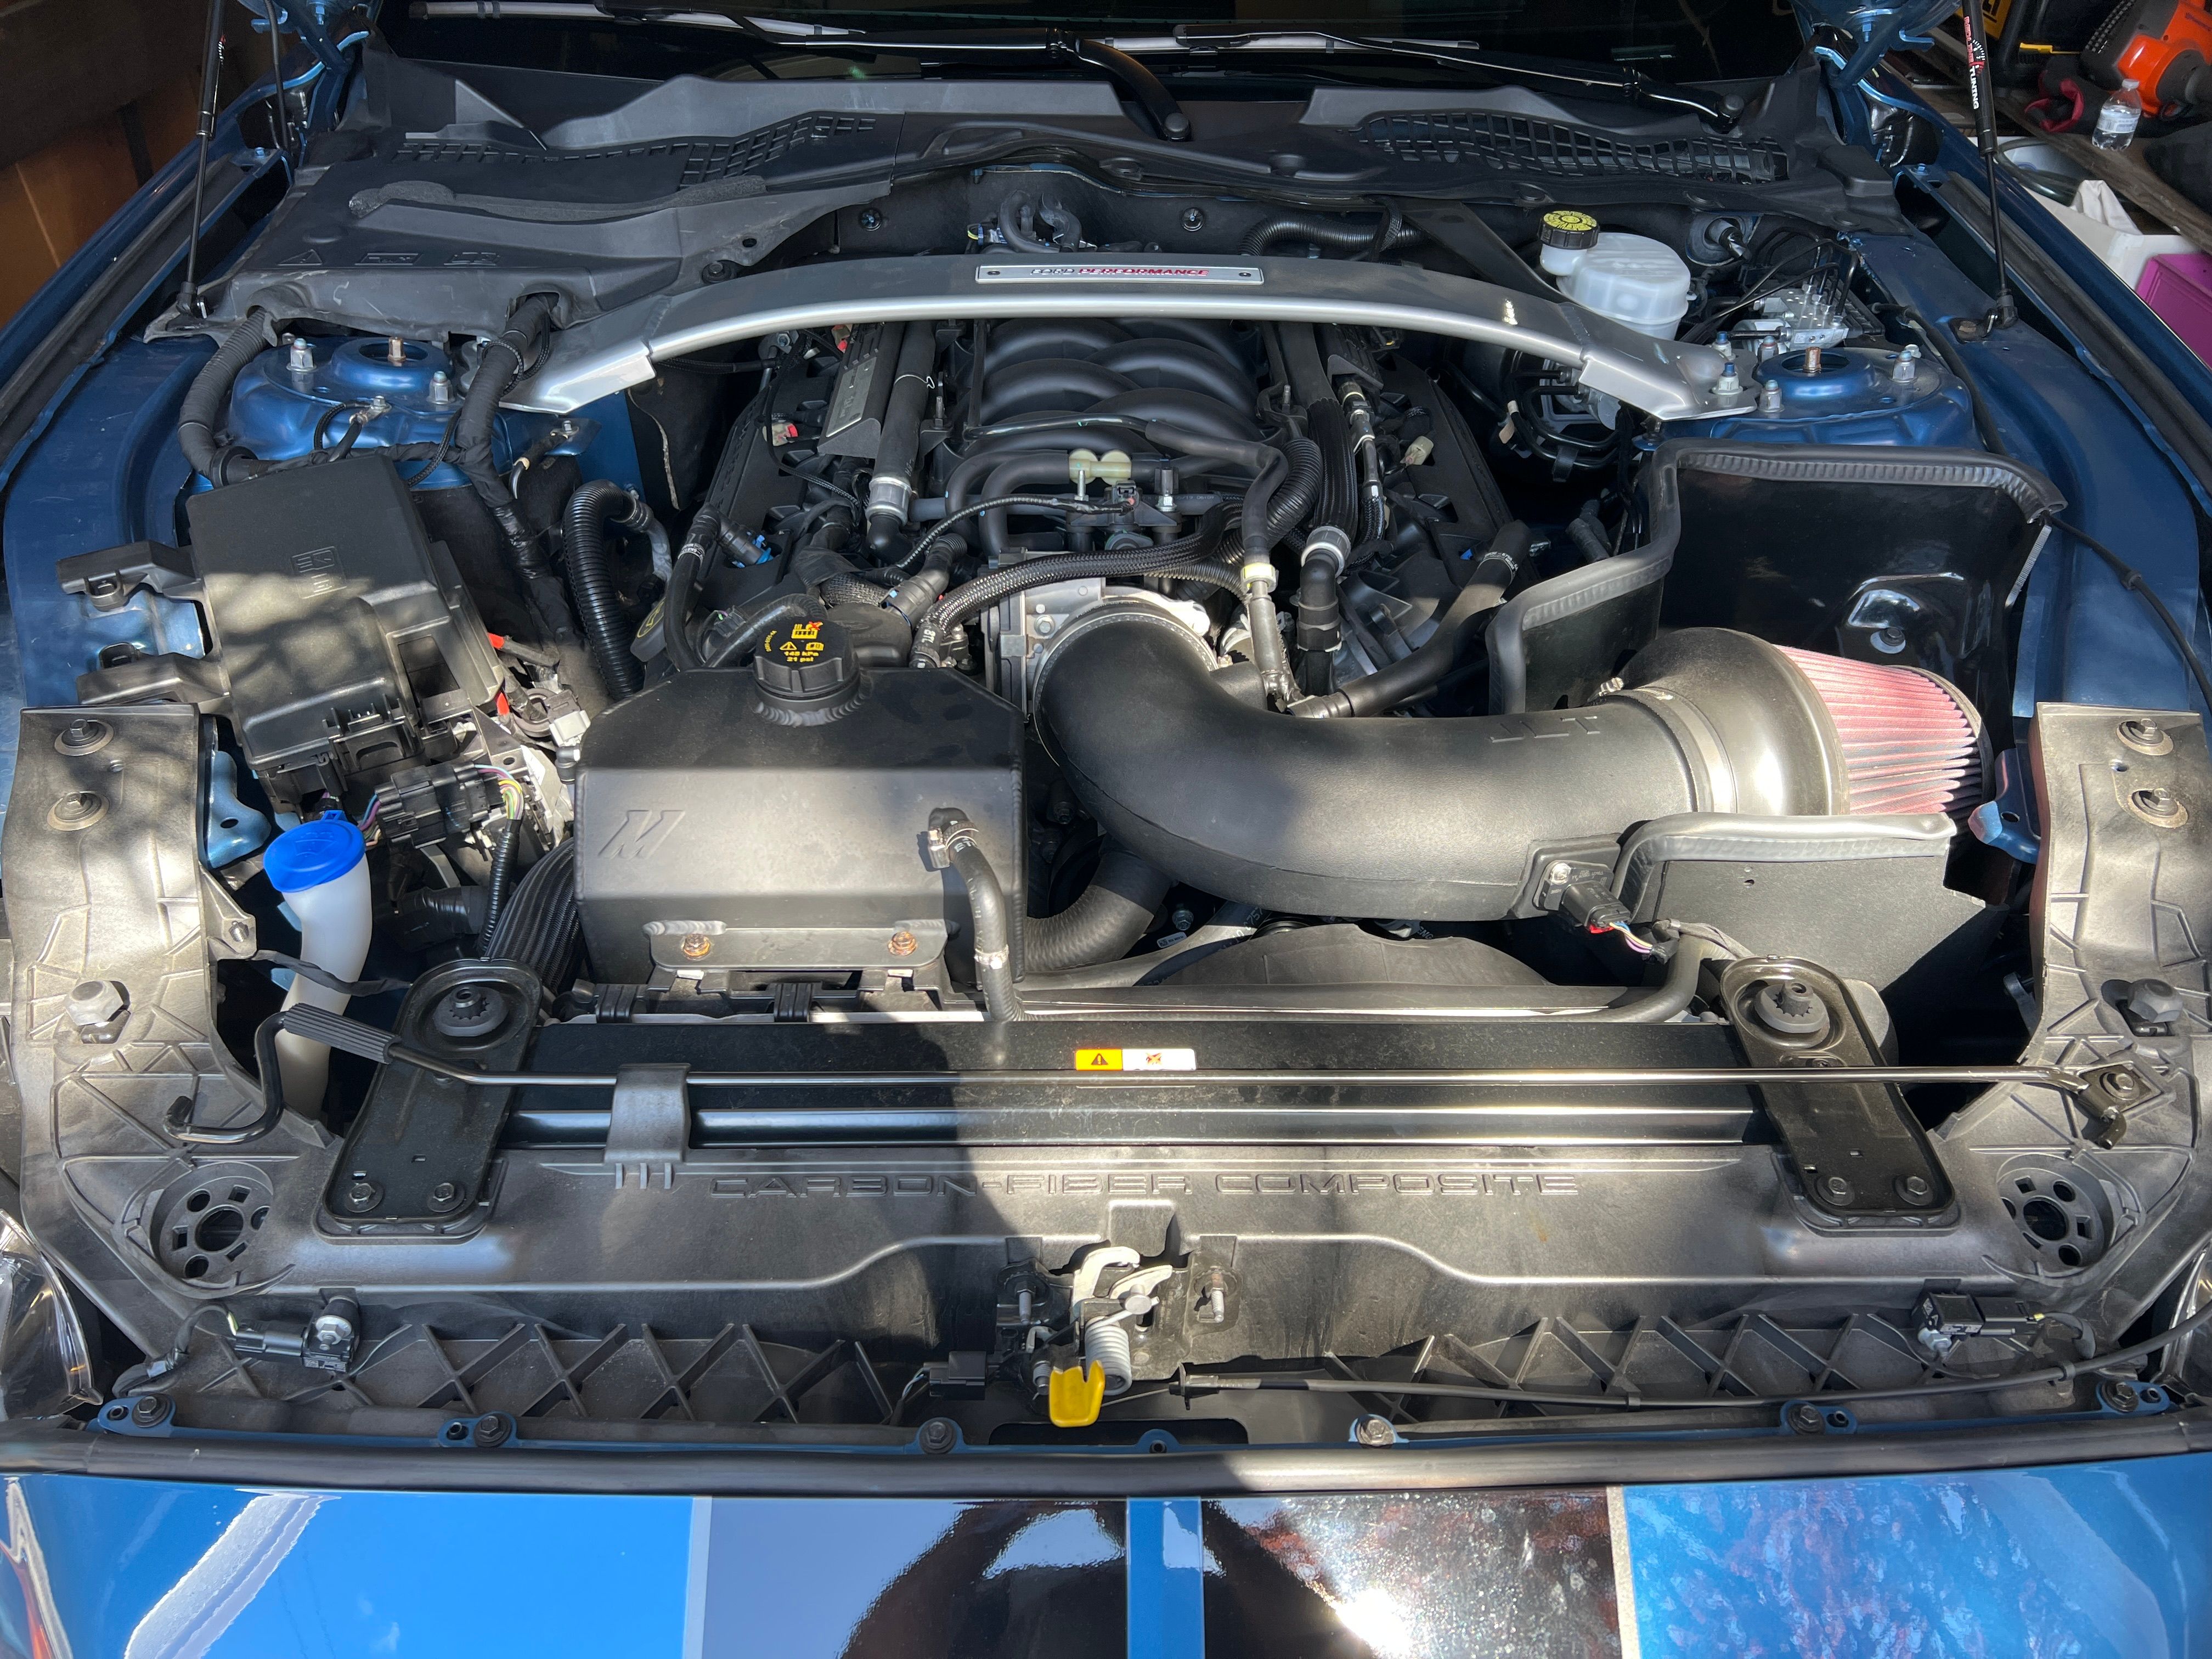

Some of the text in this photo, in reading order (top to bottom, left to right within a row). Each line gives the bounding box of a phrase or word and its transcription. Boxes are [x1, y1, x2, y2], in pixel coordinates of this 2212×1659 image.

[1970, 65, 1979, 110] TUNING
[1077, 268, 1210, 276] PERFORMANCE
[709, 1173, 1579, 1199] CARBON-FIBER COMPOSITE
